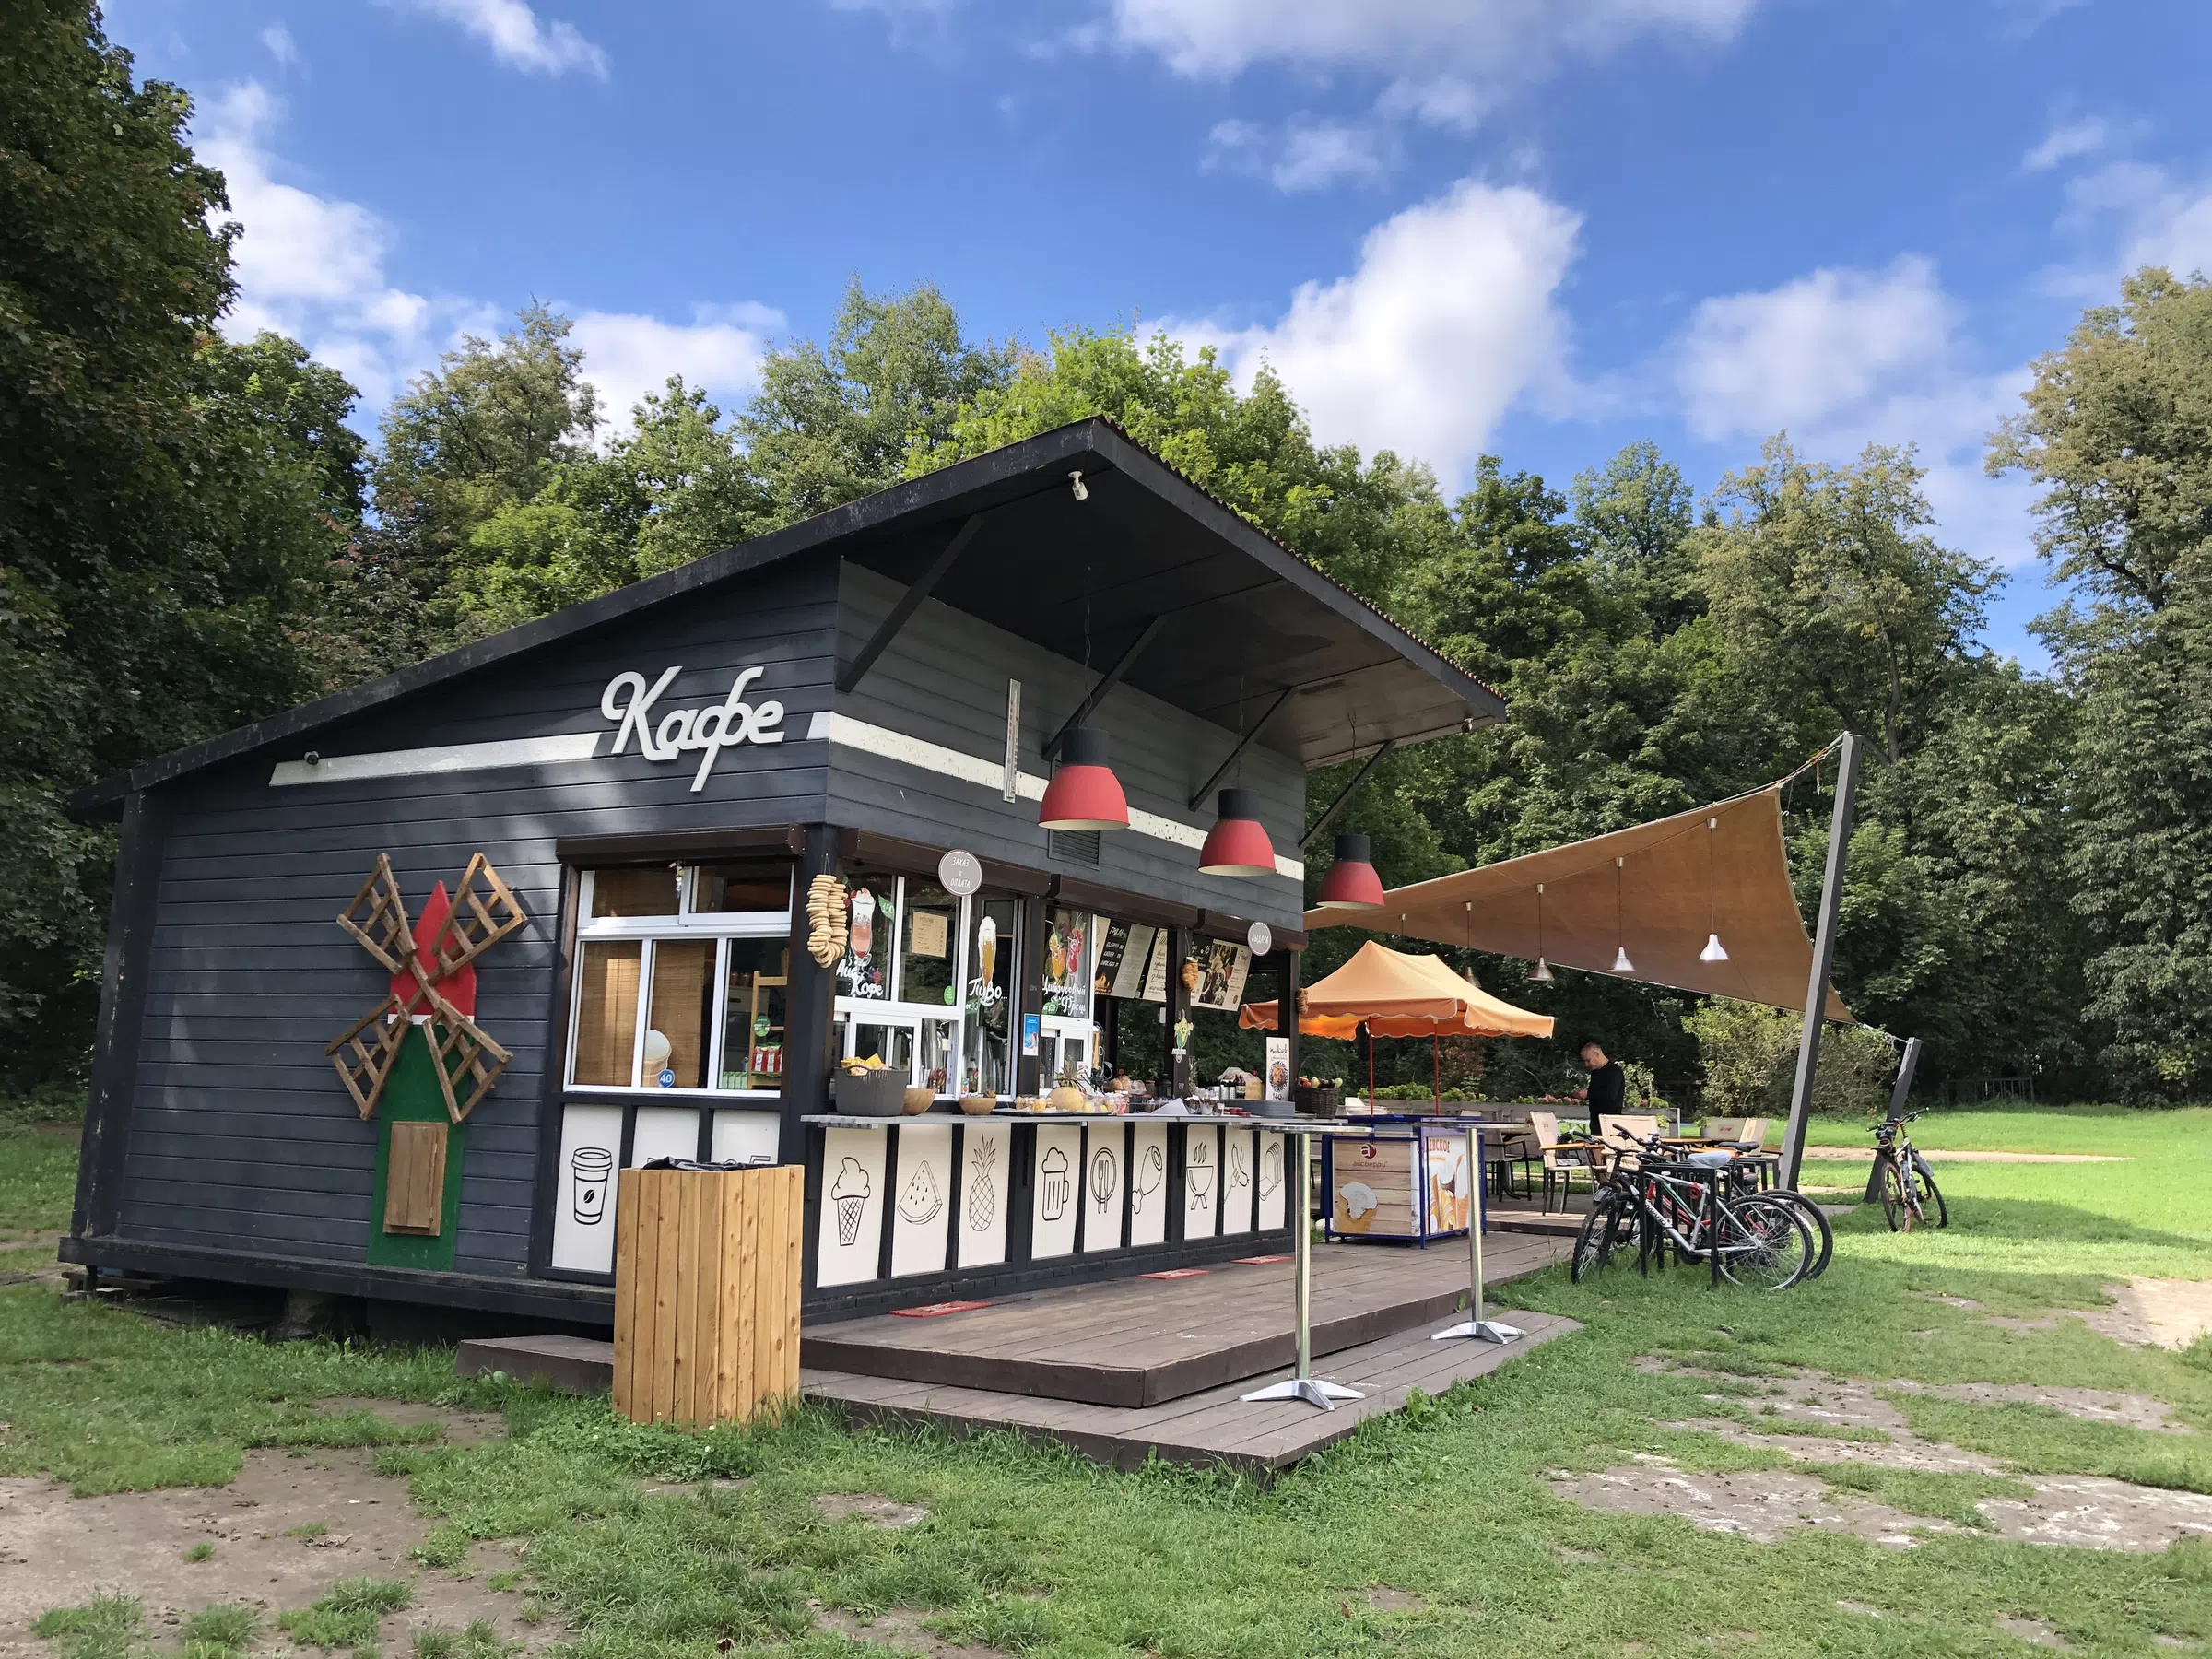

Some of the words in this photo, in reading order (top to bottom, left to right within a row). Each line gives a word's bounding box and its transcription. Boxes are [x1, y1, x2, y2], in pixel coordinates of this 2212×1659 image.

[601, 665, 784, 792] Кафе
[952, 856, 970, 867] ЗАКАЗ
[950, 877, 971, 888] ОПЛАТА
[1251, 933, 1269, 945] ВЫДАЧА
[660, 1074, 673, 1084] 40
